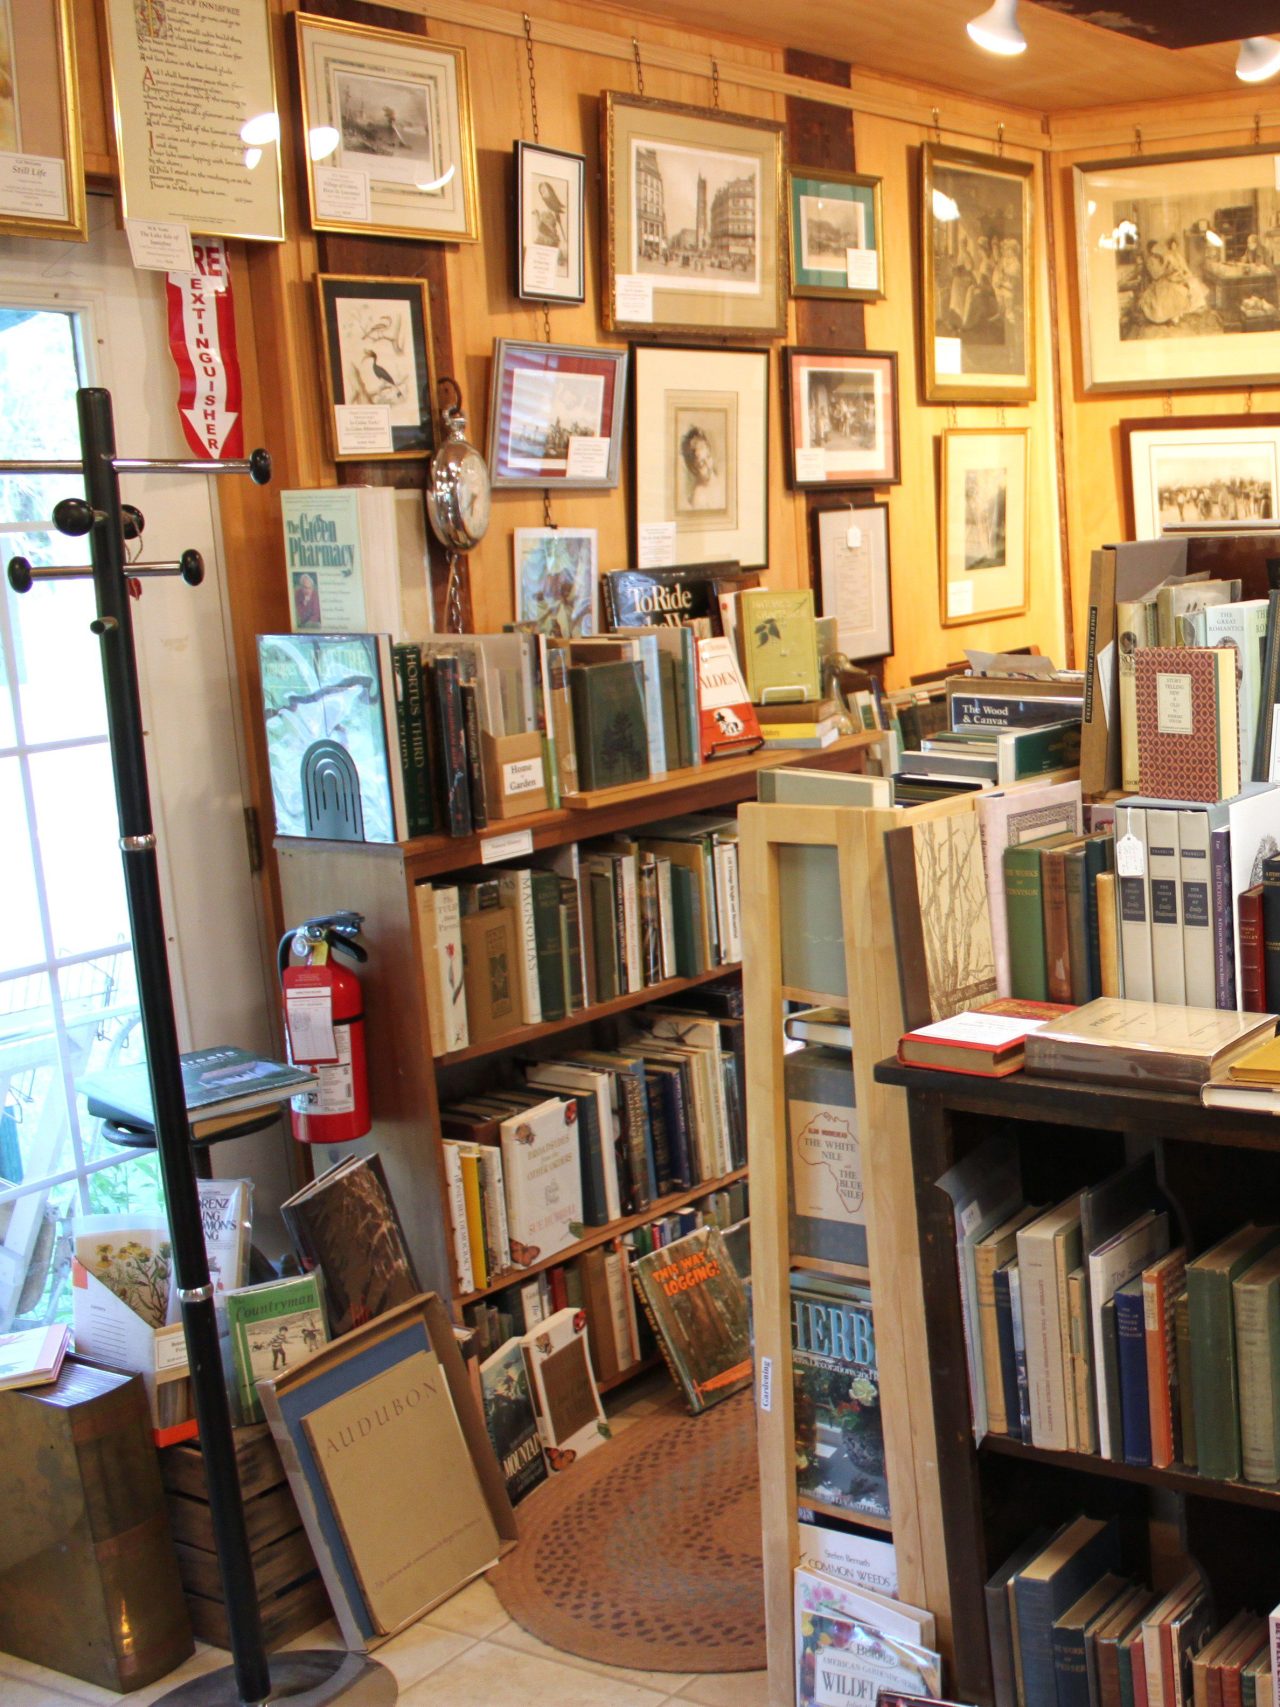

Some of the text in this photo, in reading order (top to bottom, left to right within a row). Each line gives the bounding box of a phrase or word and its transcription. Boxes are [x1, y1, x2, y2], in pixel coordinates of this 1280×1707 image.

[190, 277, 219, 450] EXTINGUISHER
[299, 512, 338, 543] Green
[288, 536, 355, 572] Pharmacy
[649, 583, 692, 612] Ride
[700, 671, 738, 690] ALDEN
[406, 654, 425, 768] HORTUS THIRD
[962, 704, 1009, 716] The Wood
[962, 714, 1008, 726] & Canvas
[511, 764, 533, 774] Home
[509, 777, 537, 791] Garden
[522, 877, 537, 971] MAGNOLIAS
[803, 1137, 856, 1153] THE WHITE
[821, 1150, 843, 1161] NILE
[839, 1169, 857, 1180] THE
[839, 1180, 863, 1191] BLUE
[840, 1189, 862, 1200] NILE
[652, 1251, 706, 1284] THIS WAS
[662, 1259, 721, 1298] LOGGING!
[235, 1292, 315, 1322] Countryman
[762, 1359, 773, 1408] Gardening
[325, 1378, 439, 1459] AUDUBON
[808, 1559, 891, 1586] COMMON WEEDS
